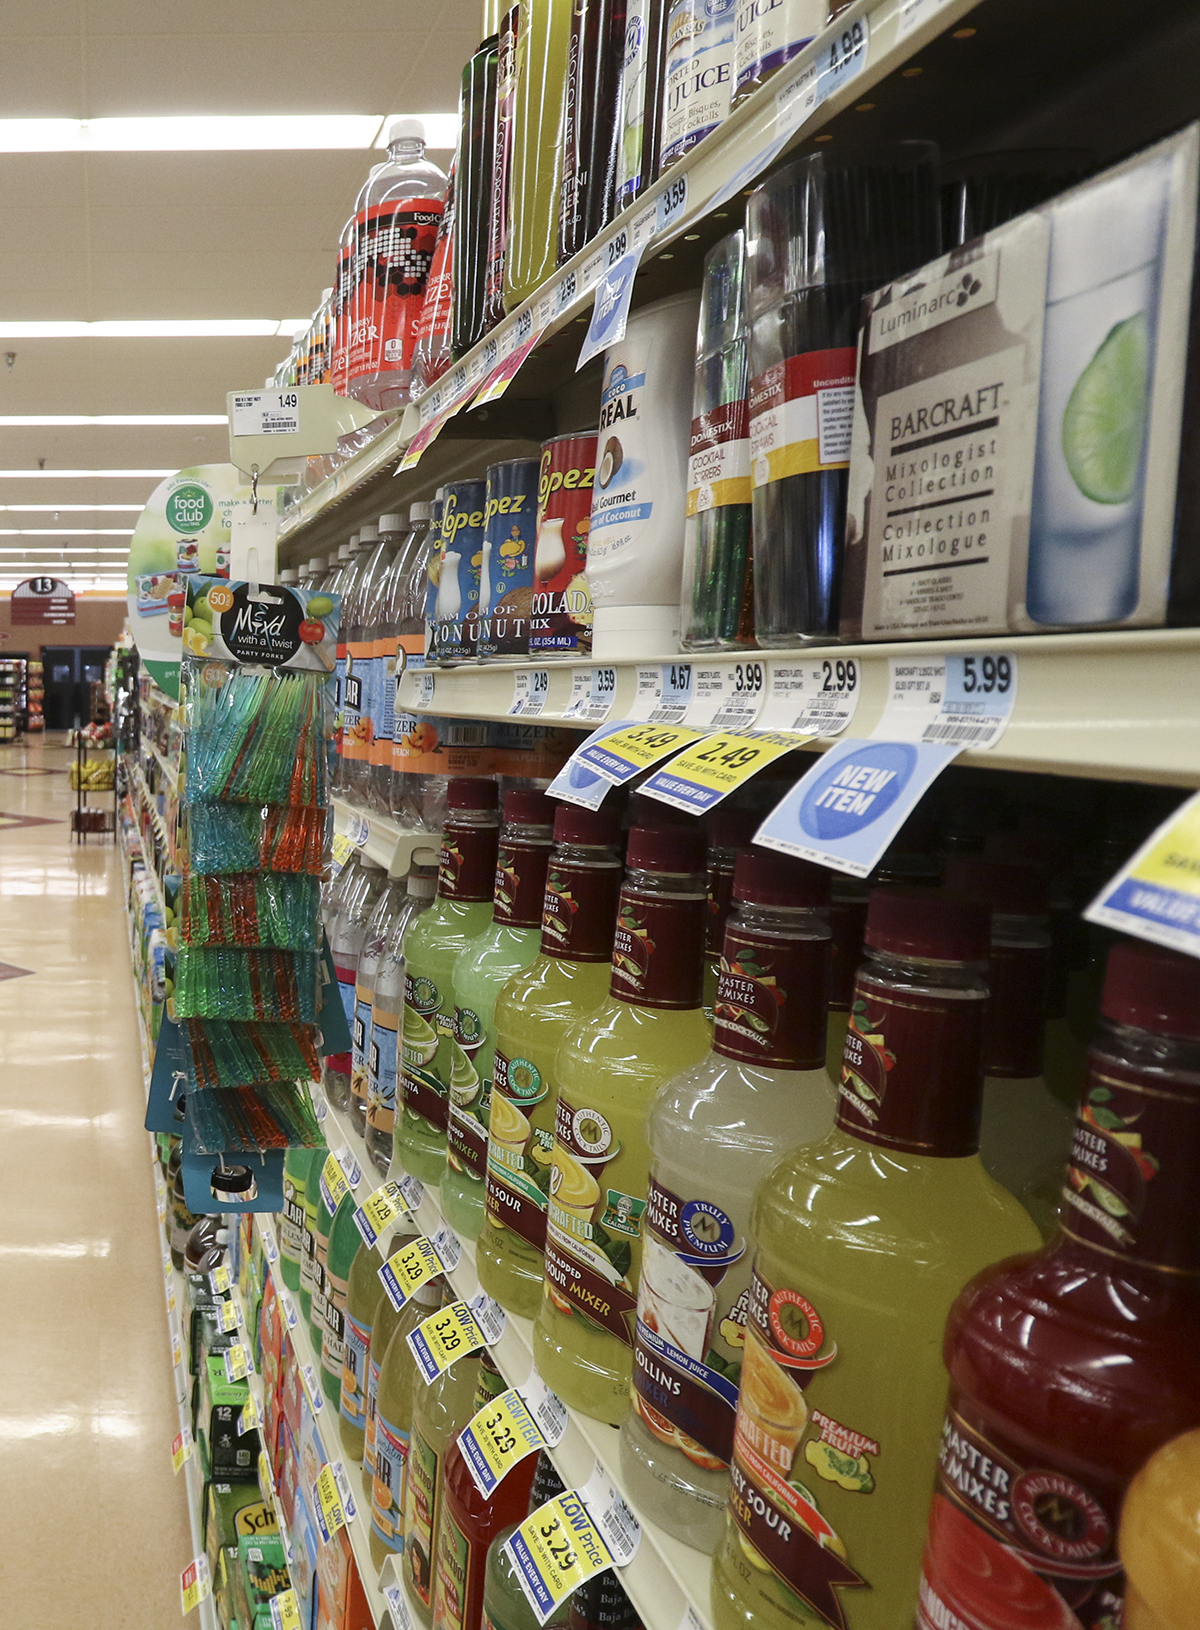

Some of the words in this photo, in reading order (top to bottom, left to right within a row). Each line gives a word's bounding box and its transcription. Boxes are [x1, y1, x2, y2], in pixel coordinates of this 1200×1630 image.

[565, 34, 580, 146] CHOCOLATE
[674, 63, 731, 111] JUICE
[664, 178, 686, 215] 3.59
[608, 232, 627, 264] 2.99
[879, 286, 957, 335] Luminarc
[279, 394, 297, 408] 1.49
[890, 382, 1003, 442] BARCRAFT
[691, 420, 734, 447] DOMESTIX
[692, 449, 726, 470] COCKTAIL
[886, 438, 997, 481] Mixologist
[886, 464, 994, 503] Collection
[174, 495, 204, 509] food
[219, 499, 240, 507] make
[600, 489, 636, 509] Gourmet
[175, 509, 204, 522] club
[605, 507, 642, 523] Coconut
[883, 509, 990, 541] Collection
[883, 532, 987, 562] Mixologue
[35, 578, 52, 592] 13
[210, 592, 226, 605] 50
[494, 604, 517, 615] OF
[238, 634, 257, 645] with
[259, 638, 267, 646] a
[271, 639, 293, 649] twist
[558, 635, 572, 646] ML)
[261, 652, 284, 660] FORKS
[534, 672, 548, 691] 2.49
[597, 669, 615, 691] 3.59
[670, 664, 691, 690] 4.67
[736, 664, 762, 691] 3.99
[822, 660, 856, 692] 2.99
[963, 655, 1012, 694] 5.99
[627, 727, 679, 749] 3.49
[586, 749, 603, 761] VALUE
[601, 755, 618, 768] EVERY
[615, 762, 632, 774] DAY
[696, 741, 761, 769] 2.49
[676, 759, 695, 771] SAVE
[715, 771, 738, 783] CARD
[832, 764, 897, 793] NEW
[654, 776, 679, 792] VALUE
[676, 783, 699, 798] EVERY
[695, 791, 714, 803] DAY
[815, 787, 877, 817] ITEM
[719, 974, 754, 993] MASTER
[723, 988, 756, 1005] MIXES
[459, 1020, 479, 1042] PREMIUM
[508, 1073, 538, 1096] COCKTAILS
[510, 1059, 541, 1083] AUTHENTIC
[575, 1109, 611, 1137] AUTHENTIC
[453, 1138, 479, 1162] MIXER
[574, 1128, 607, 1153] COCKTAILS
[373, 1196, 392, 1221] 3.29
[495, 1189, 521, 1213] SOUR
[618, 1201, 632, 1210] ONLY
[693, 1203, 730, 1225] TRULY
[606, 1218, 634, 1232] CALORIES
[617, 1209, 628, 1224] 5
[648, 1208, 678, 1237] MIXES
[683, 1219, 729, 1253] PREMIUM
[416, 1238, 434, 1258] LOW
[425, 1256, 439, 1274] Price
[571, 1240, 596, 1263] CALIFORNIA
[402, 1252, 423, 1281] 3.29
[556, 1256, 582, 1280] ADDED
[384, 1267, 392, 1281] VALUE
[389, 1279, 398, 1293] EVERY
[395, 1290, 403, 1302] DAY
[569, 1282, 611, 1317] MIXER
[775, 1289, 822, 1333] AUTHENTIC
[436, 1318, 461, 1352] 3.29
[451, 1302, 472, 1326] LOW
[463, 1324, 479, 1347] Price
[771, 1311, 816, 1356] COCKTAILS
[414, 1332, 423, 1349] VALUE
[420, 1347, 431, 1364] EVERY
[427, 1362, 436, 1374] DAY
[667, 1347, 688, 1366] LEMON
[687, 1360, 709, 1379] JUICE
[635, 1348, 681, 1396] COLLINS
[217, 1406, 232, 1418] 12
[502, 1391, 525, 1419] NEW
[516, 1418, 542, 1448] ITEM
[476, 1421, 485, 1435] SAVE
[487, 1441, 498, 1454] WITH
[493, 1453, 504, 1469] CARD
[486, 1412, 516, 1454] 3.29
[812, 1409, 880, 1455] PREMIUM
[821, 1430, 861, 1460] FRUIT
[465, 1433, 476, 1452] VALUE
[473, 1451, 484, 1468] EVERY
[482, 1466, 492, 1483] DAY
[943, 1417, 1009, 1493] MASTER
[215, 1483, 231, 1494] 12
[762, 1467, 798, 1507] CALIFORNIA
[947, 1458, 1010, 1521] MIXES
[331, 1503, 344, 1525] LOW
[748, 1488, 792, 1542] SOUR
[1025, 1477, 1108, 1529] AUTHENTIC
[559, 1494, 591, 1531] LOW
[579, 1532, 604, 1567] Price
[1019, 1501, 1099, 1556] COCKTAILS
[527, 1525, 539, 1544] SAVE
[541, 1552, 552, 1570] WITH
[549, 1568, 563, 1590] CARD
[541, 1517, 578, 1571] 3.29
[515, 1539, 528, 1564] VALUE
[525, 1562, 540, 1587] EVERY
[536, 1585, 549, 1603] DAY
[599, 1611, 621, 1623] Baja
